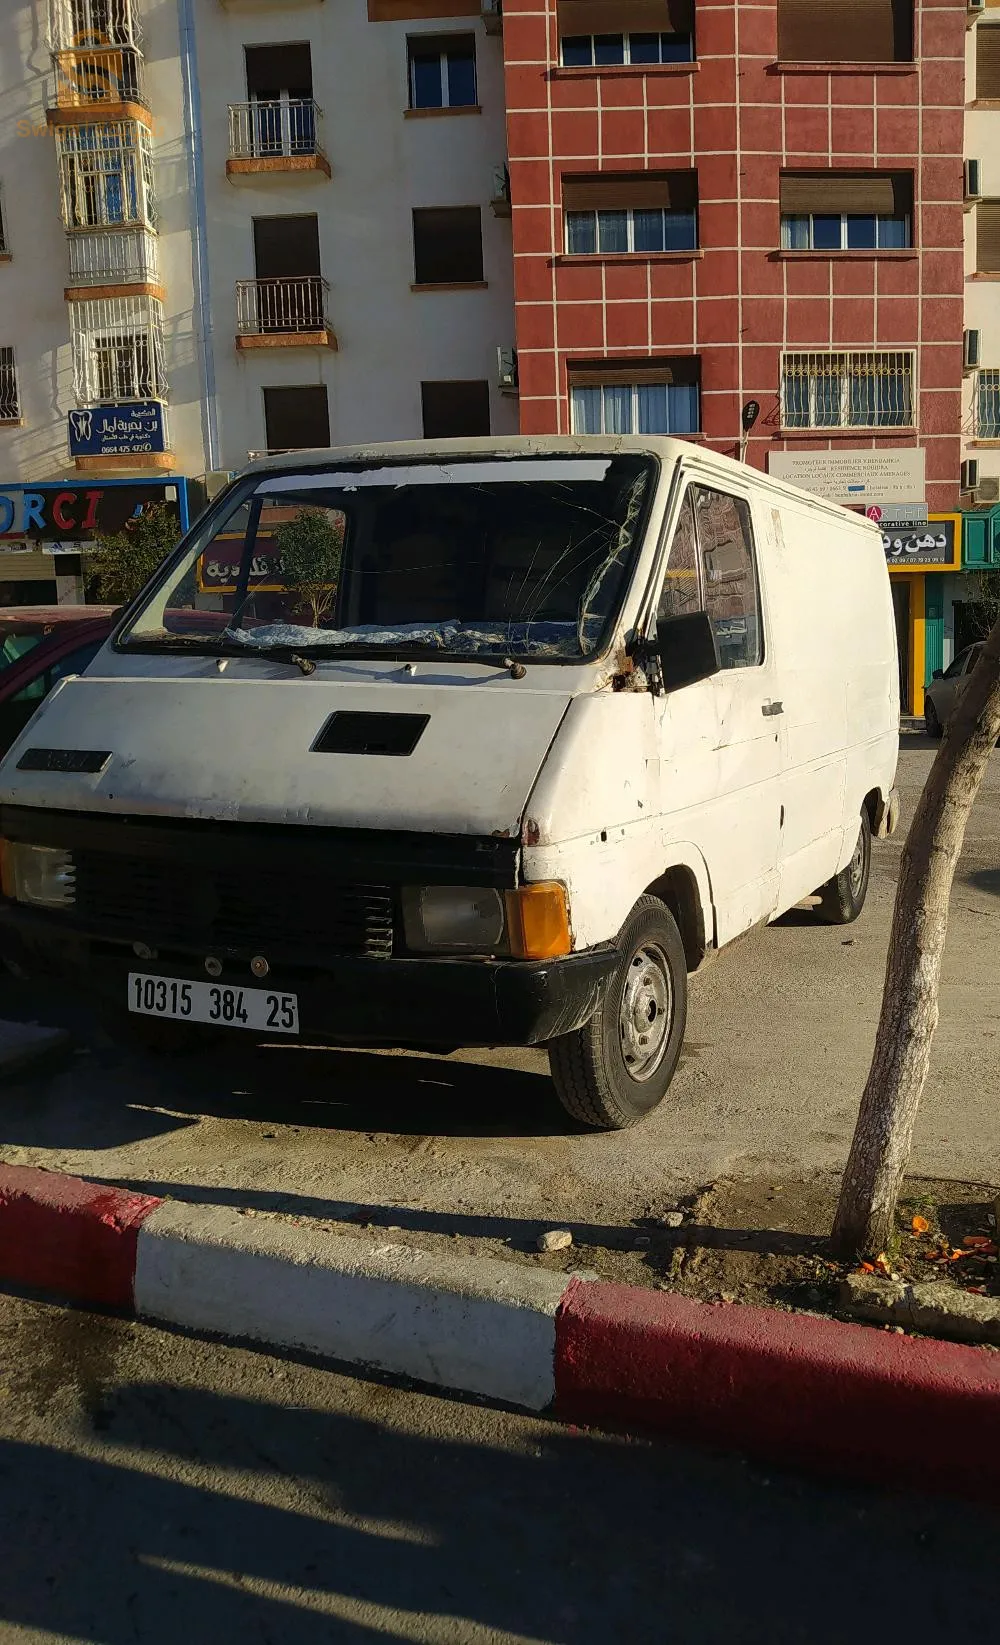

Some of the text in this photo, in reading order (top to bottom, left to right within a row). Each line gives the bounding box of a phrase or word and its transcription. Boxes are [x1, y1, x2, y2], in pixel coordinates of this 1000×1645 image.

[905, 534, 947, 553] دهن
[134, 977, 294, 1028] 10315 384 25
